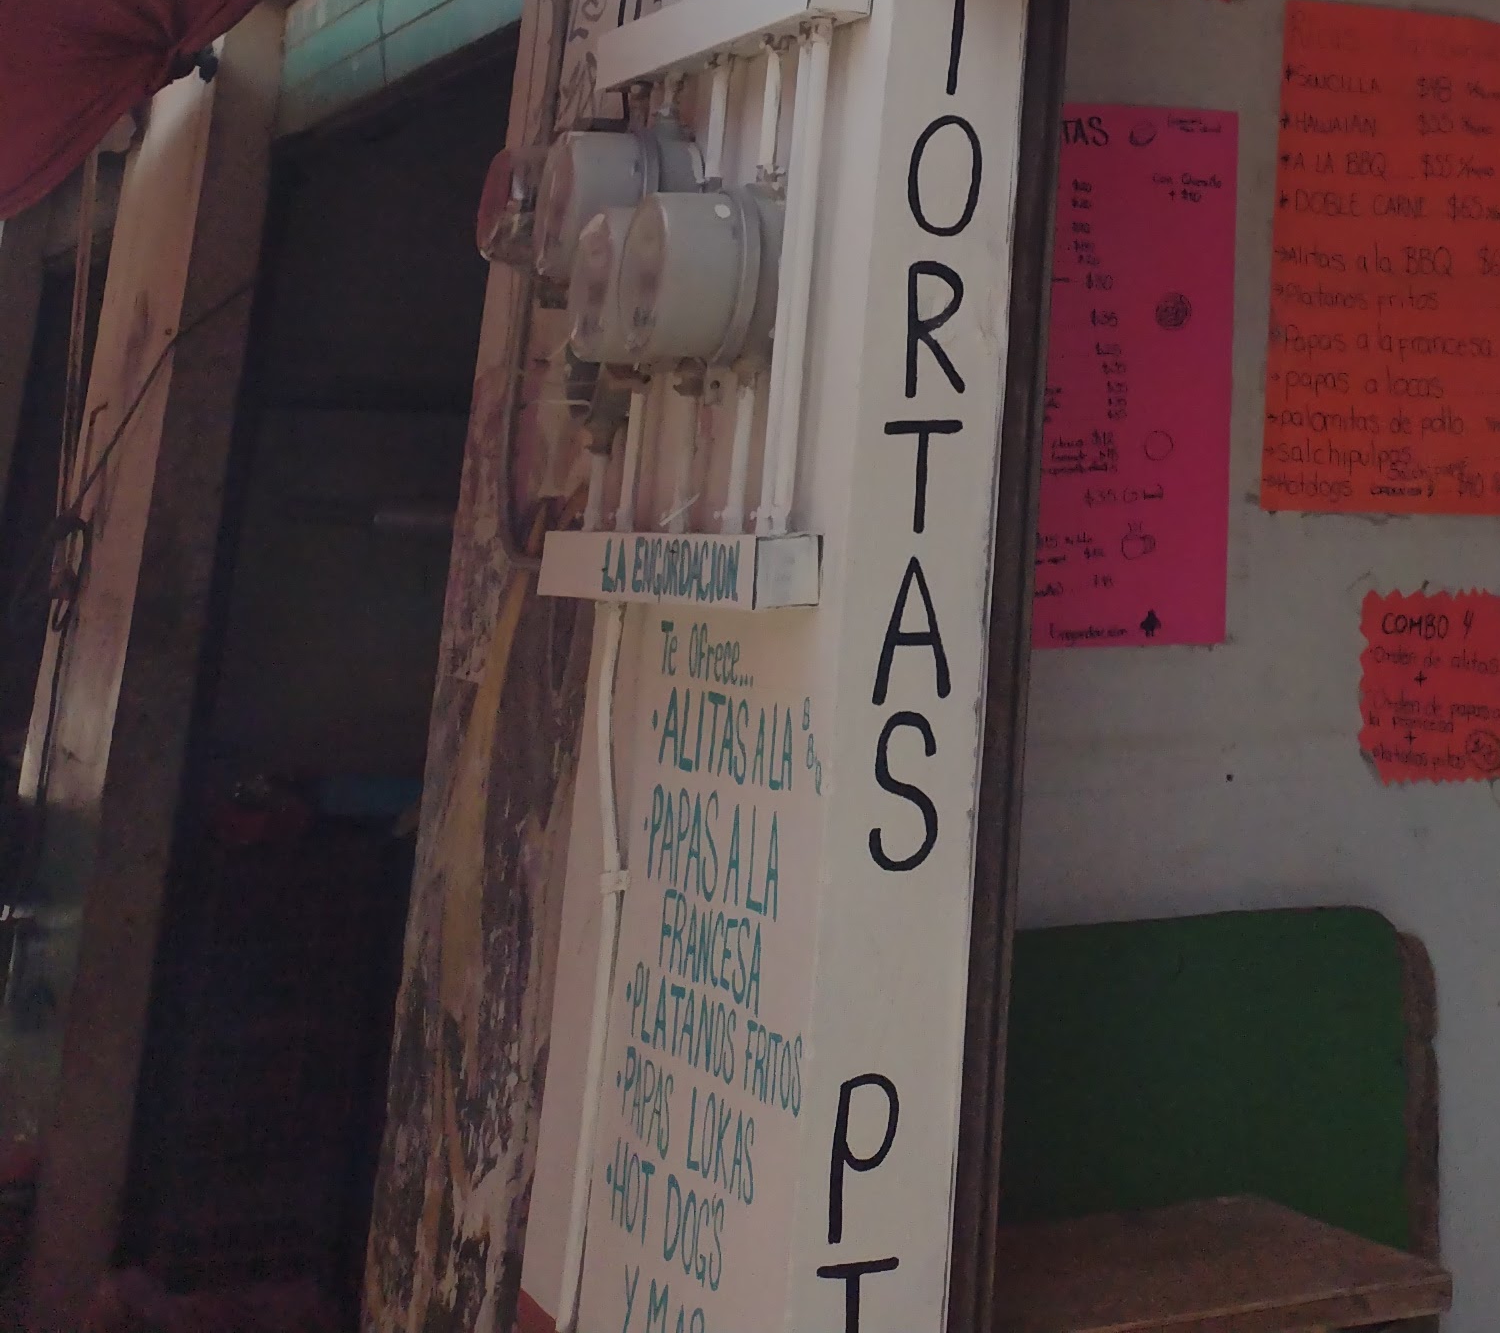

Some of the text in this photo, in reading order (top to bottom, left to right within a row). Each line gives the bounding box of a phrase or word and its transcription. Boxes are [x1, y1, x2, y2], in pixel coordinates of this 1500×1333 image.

[1345, 150, 1389, 182] BBQ
[1403, 245, 1453, 277] BBQ
[602, 537, 626, 593] LA
[1381, 612, 1450, 640] COMBO
[658, 686, 749, 785] ALITAS
[769, 702, 793, 792] LA
[647, 783, 780, 923] PAPAS A LA
[658, 888, 762, 1018] FRANCESA
[631, 961, 804, 1118] PLATANOS FRITOS
[621, 1046, 756, 1206] PAPAS LOKAS
[610, 1136, 656, 1246] HOT
